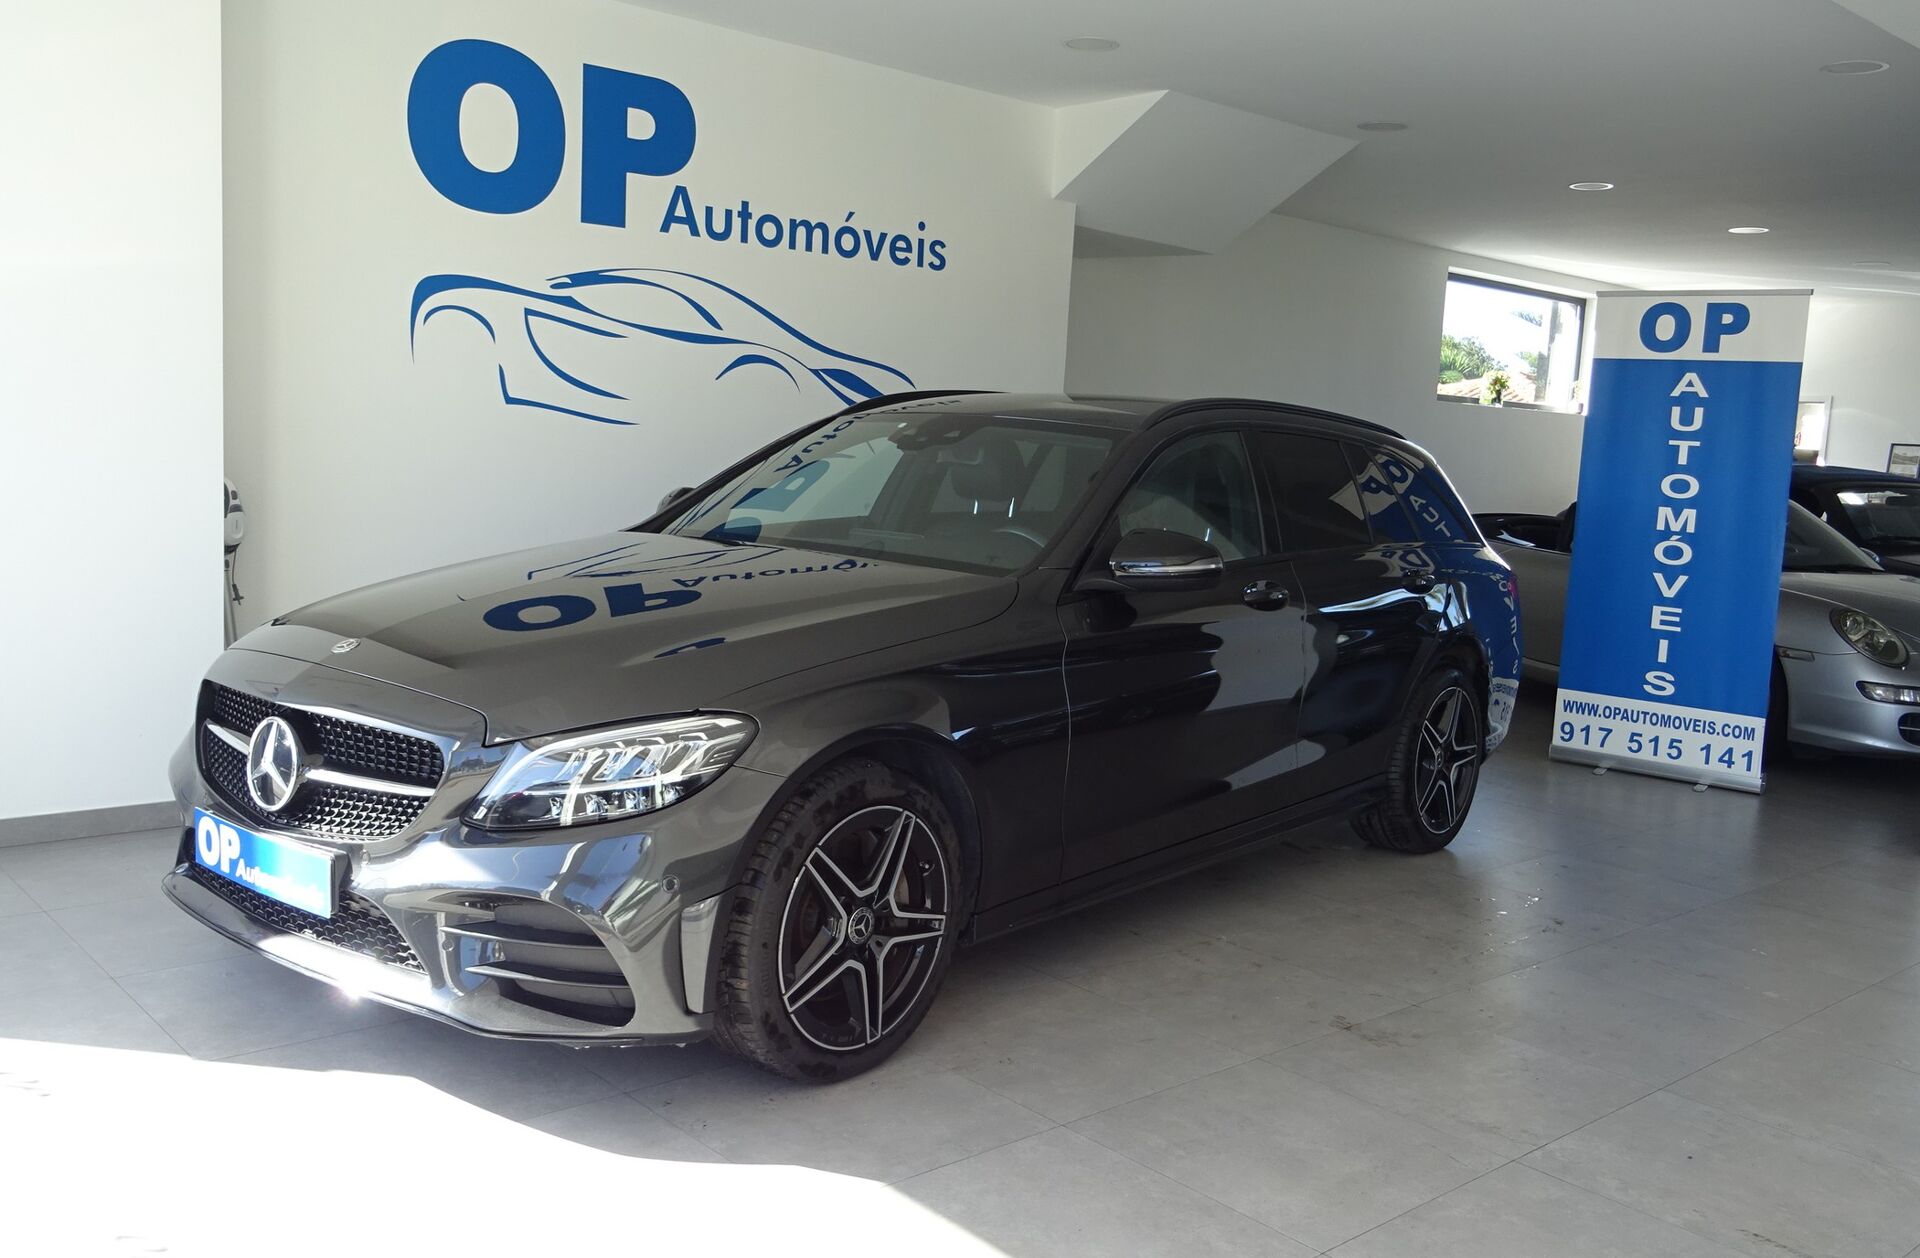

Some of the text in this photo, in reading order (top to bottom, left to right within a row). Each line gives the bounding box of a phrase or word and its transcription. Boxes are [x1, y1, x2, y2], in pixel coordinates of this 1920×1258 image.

[406, 38, 946, 271] OP Automóveis
[1639, 302, 1751, 353] OP
[1643, 372, 1709, 696] AUTOMÓVEIS
[1559, 721, 1754, 772] 917 515 141
[1562, 699, 1756, 741] WWW.OPAUTOMOVEIS.COM
[197, 815, 241, 874] OP
